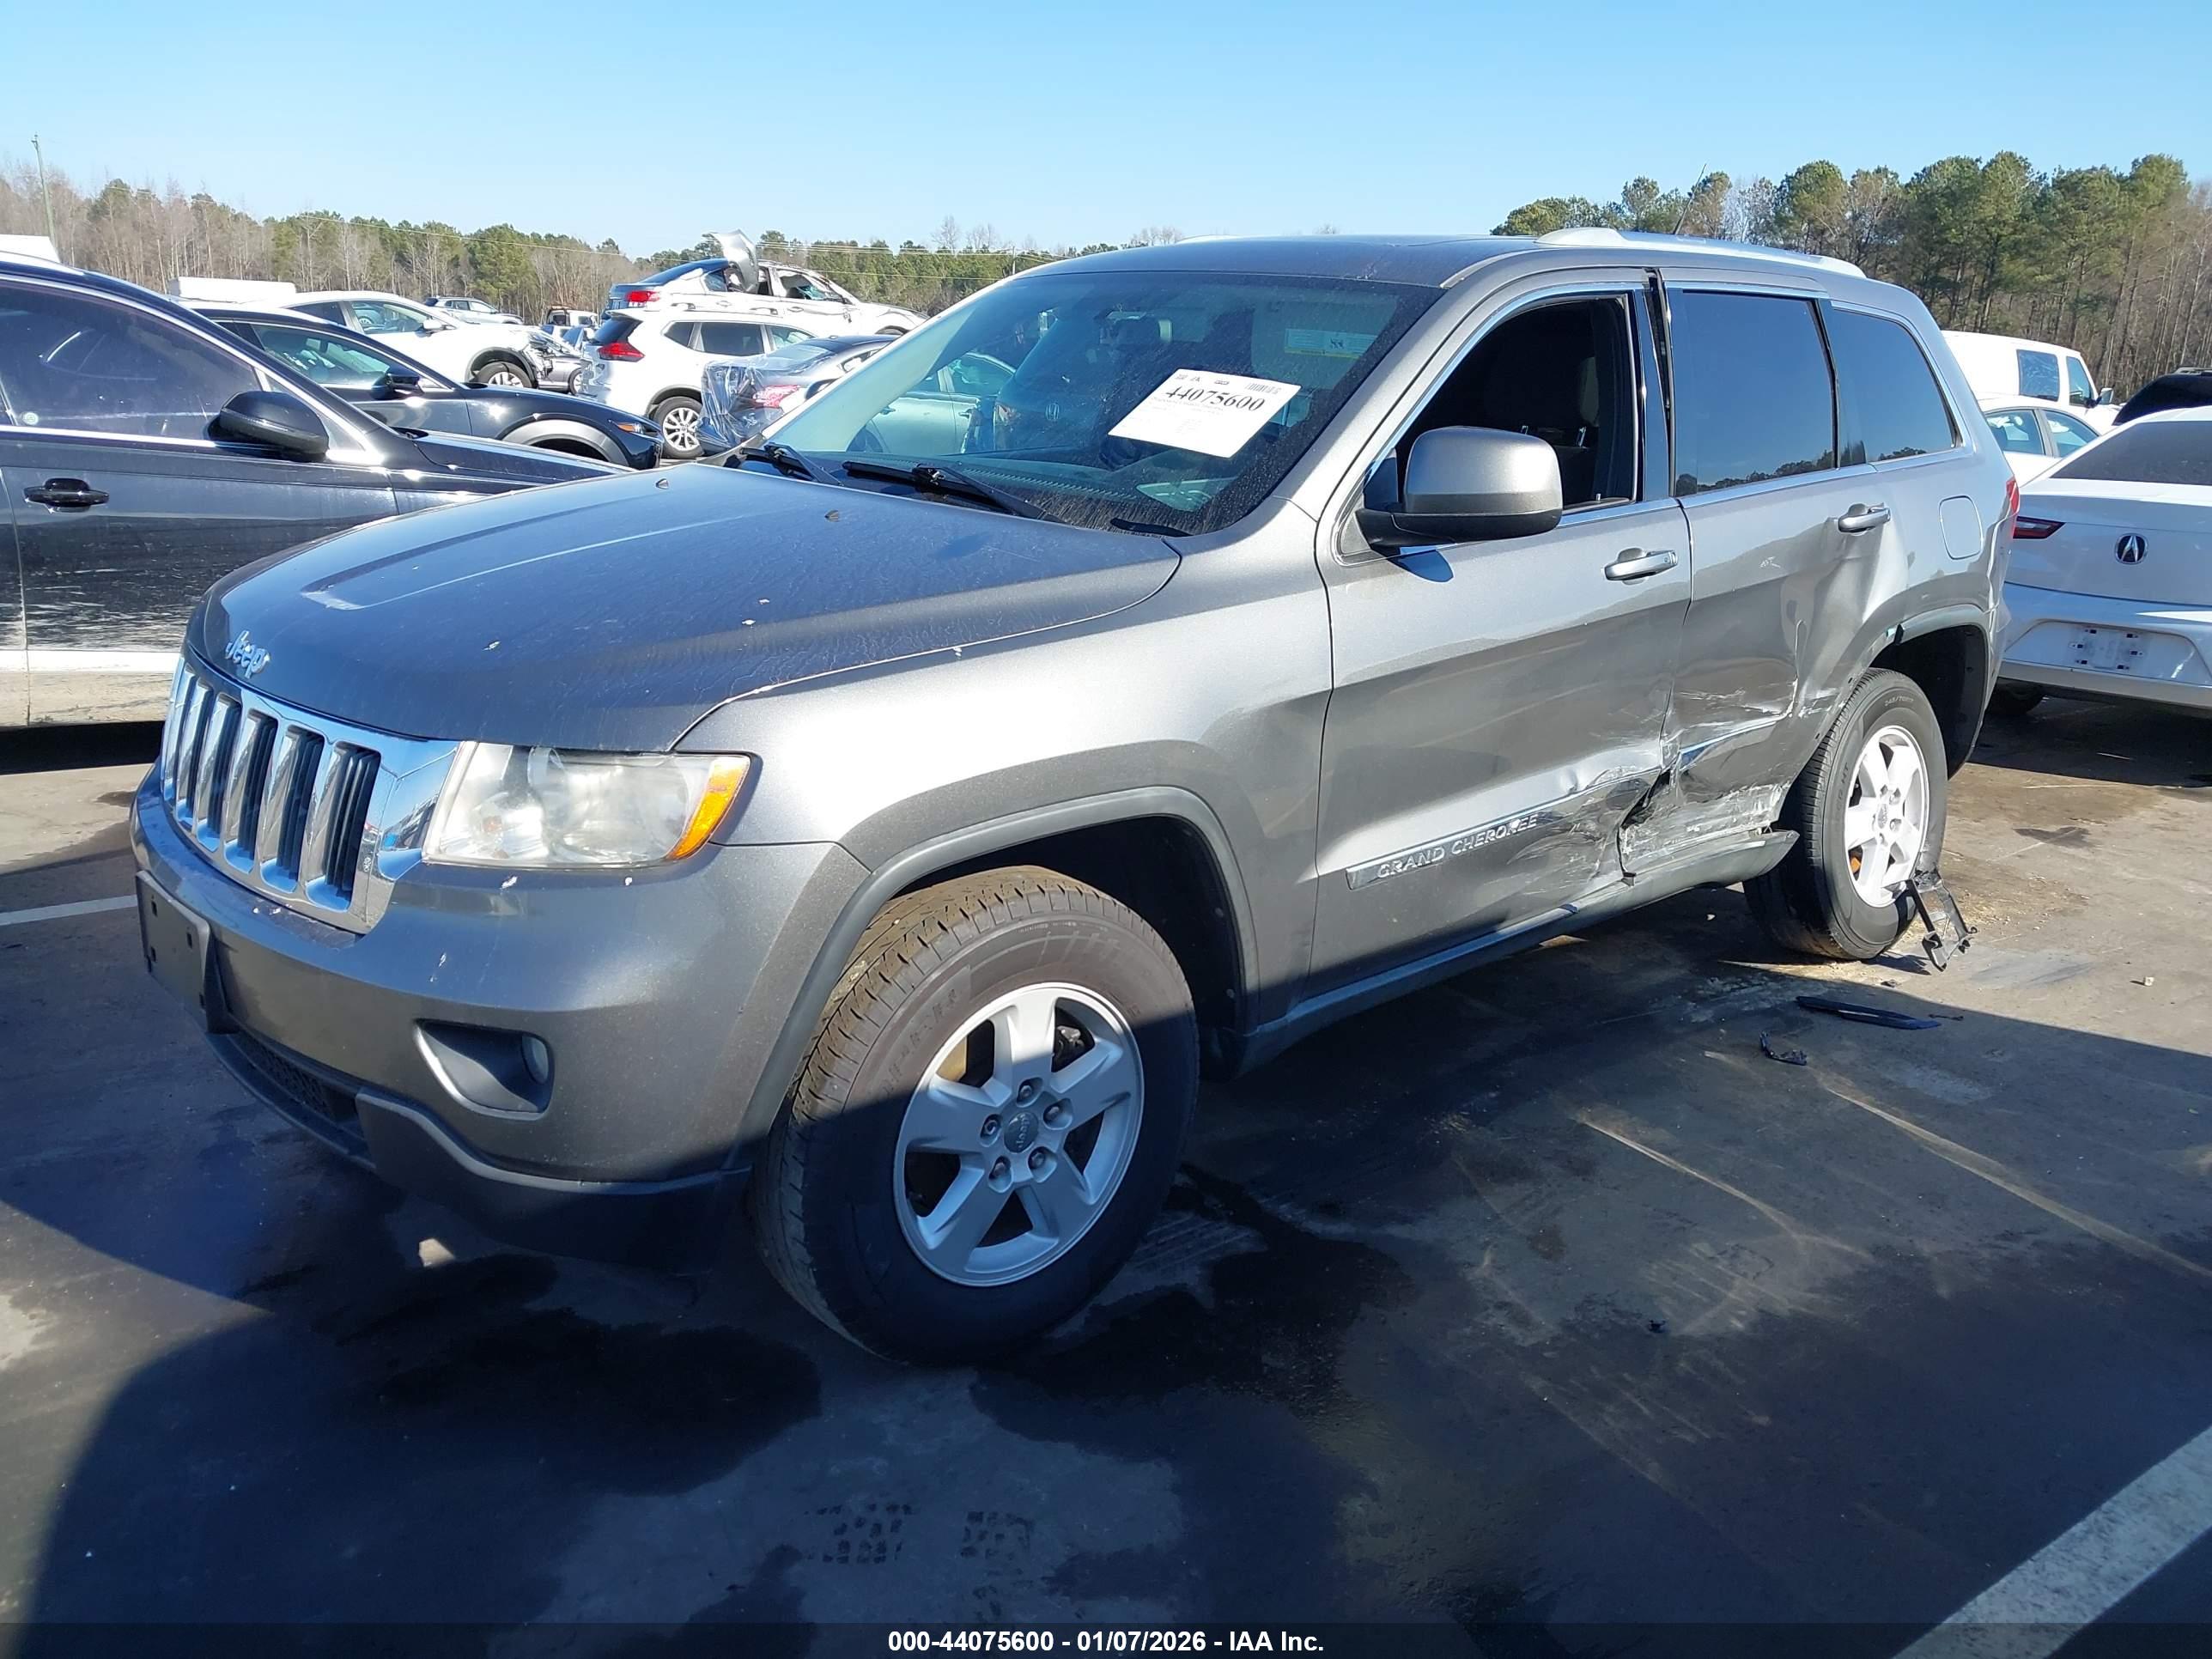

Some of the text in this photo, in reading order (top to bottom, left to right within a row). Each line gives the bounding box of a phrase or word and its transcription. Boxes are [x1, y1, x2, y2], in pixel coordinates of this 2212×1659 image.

[1165, 386, 1266, 411] 44075600
[224, 629, 270, 679] Jeep
[1376, 813, 1539, 878] GRAND CHEROKEE
